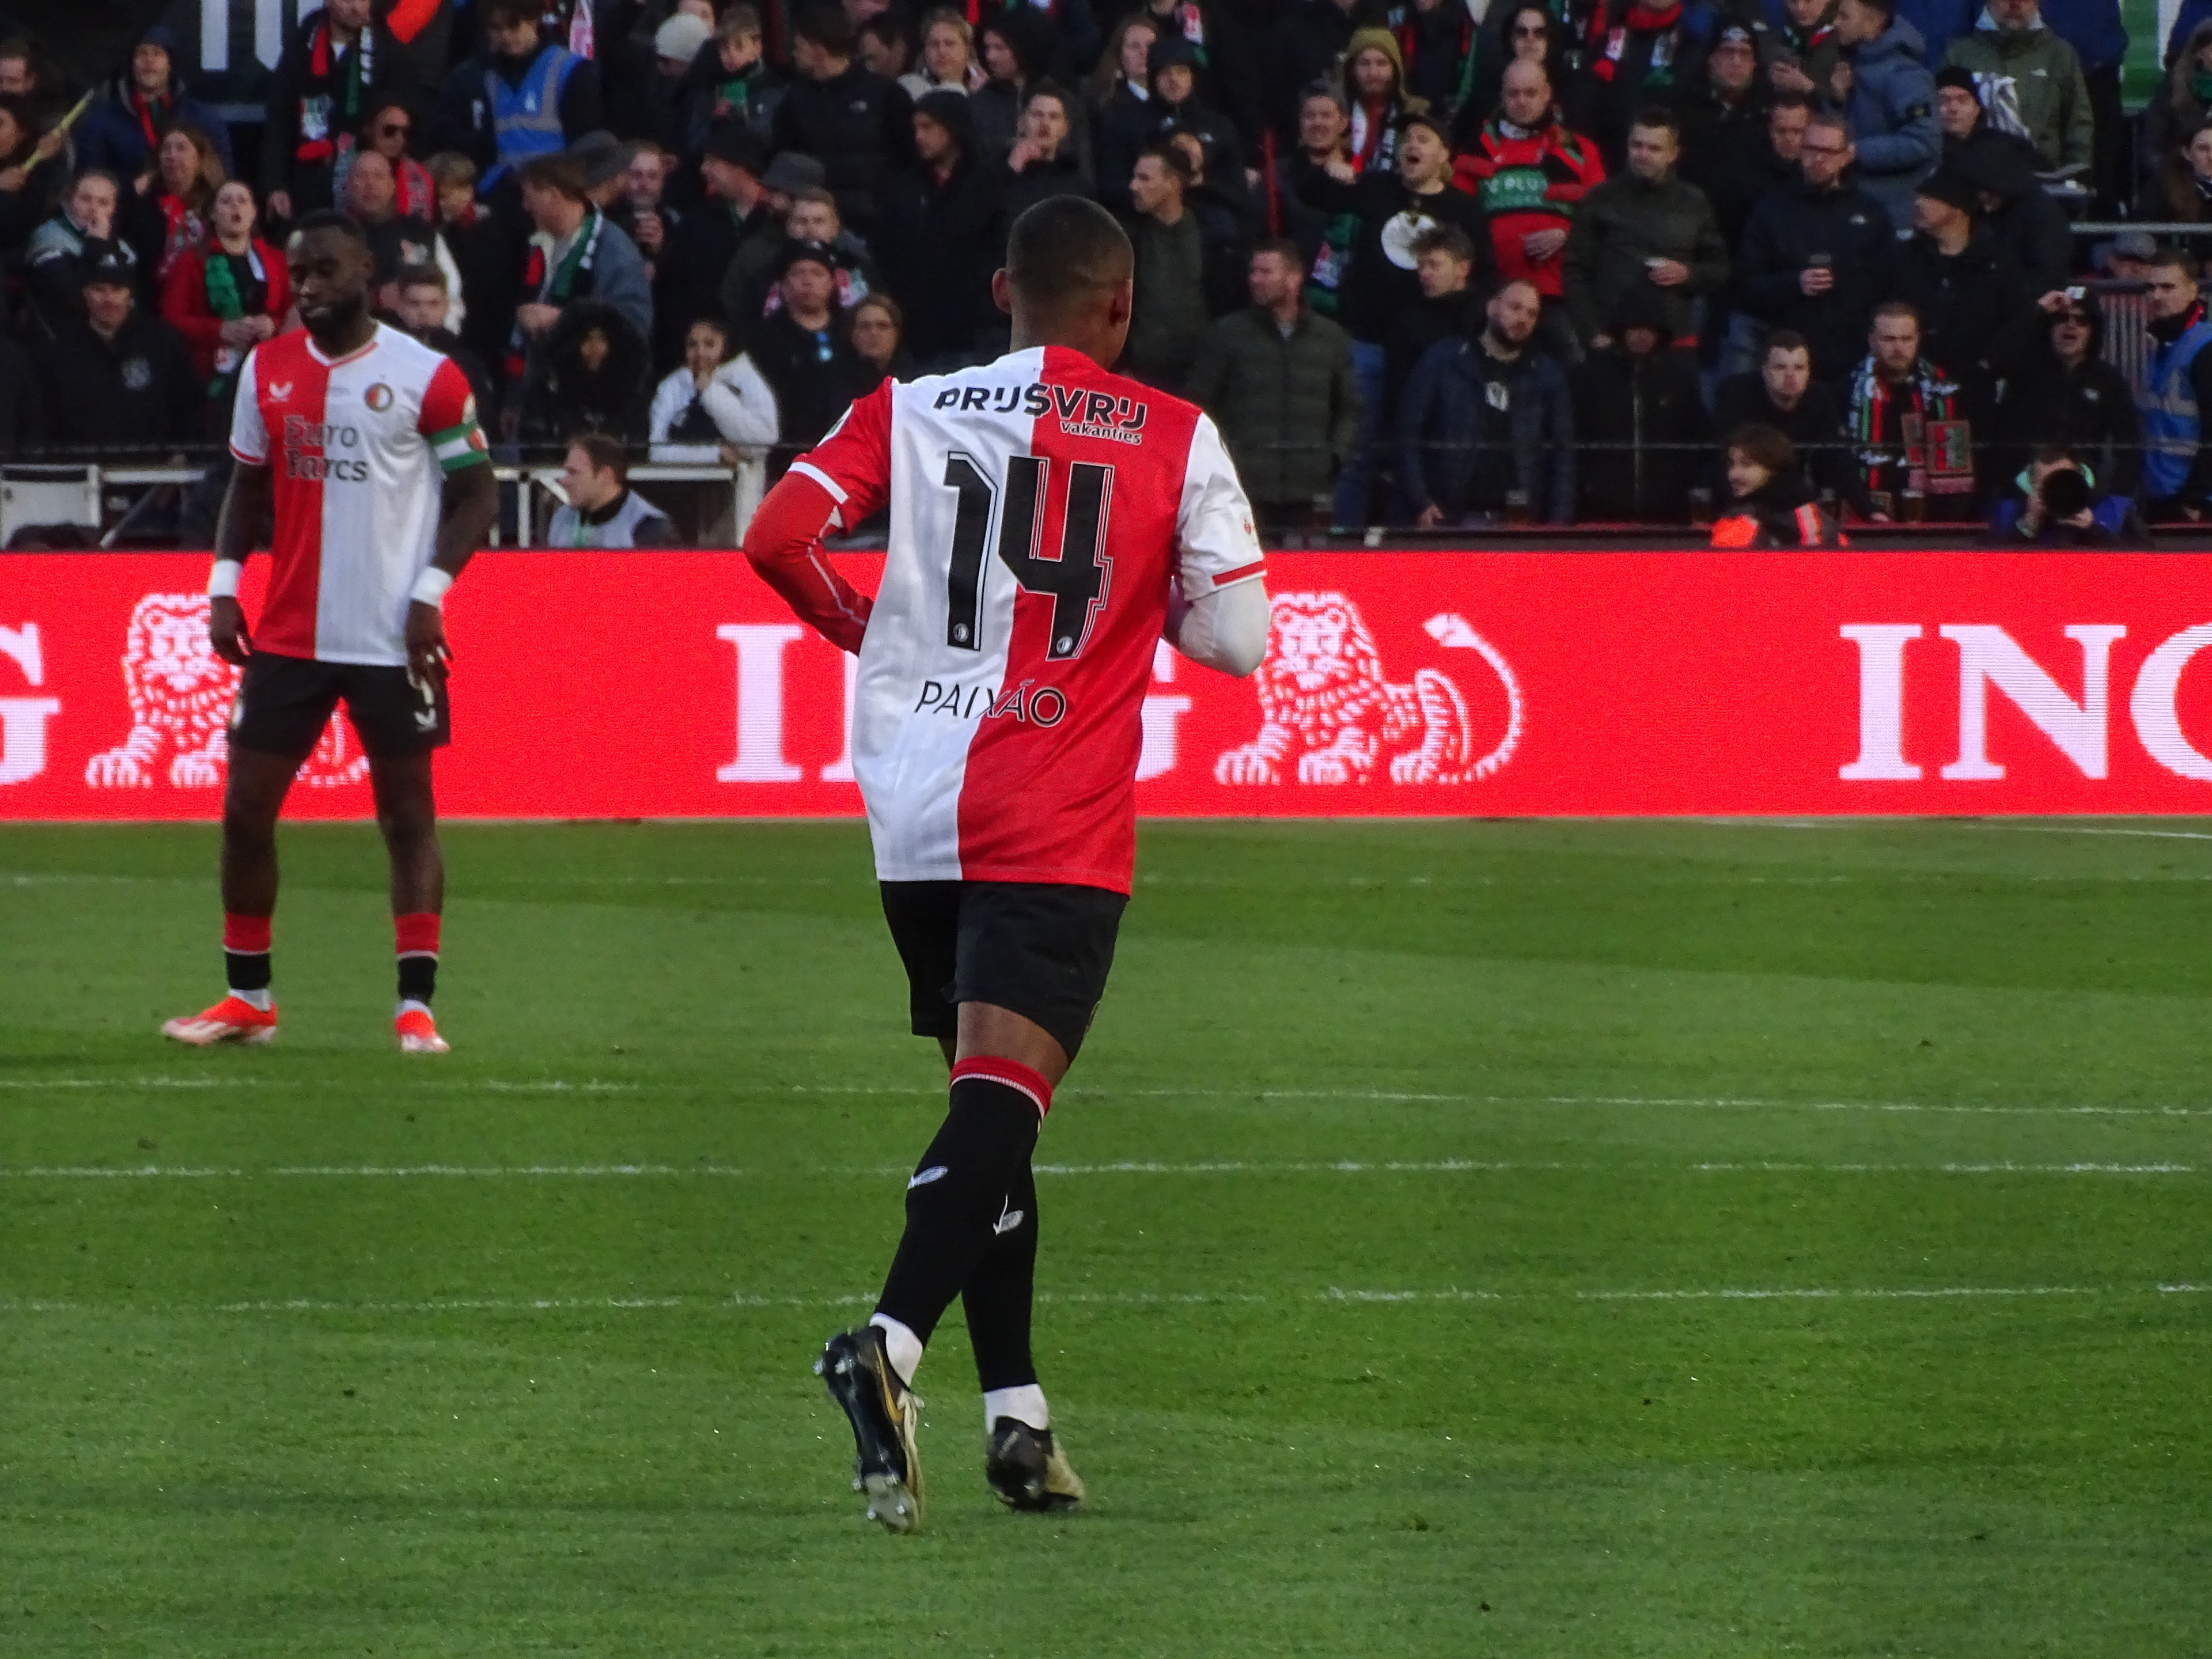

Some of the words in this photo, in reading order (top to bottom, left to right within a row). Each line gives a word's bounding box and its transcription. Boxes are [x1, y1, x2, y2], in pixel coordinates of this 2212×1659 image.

[283, 414, 358, 448] Euro
[1059, 421, 1143, 446] vakanties
[285, 446, 368, 483] Parcs
[944, 450, 1115, 662] 14
[914, 678, 1066, 728] PAIXÃO
